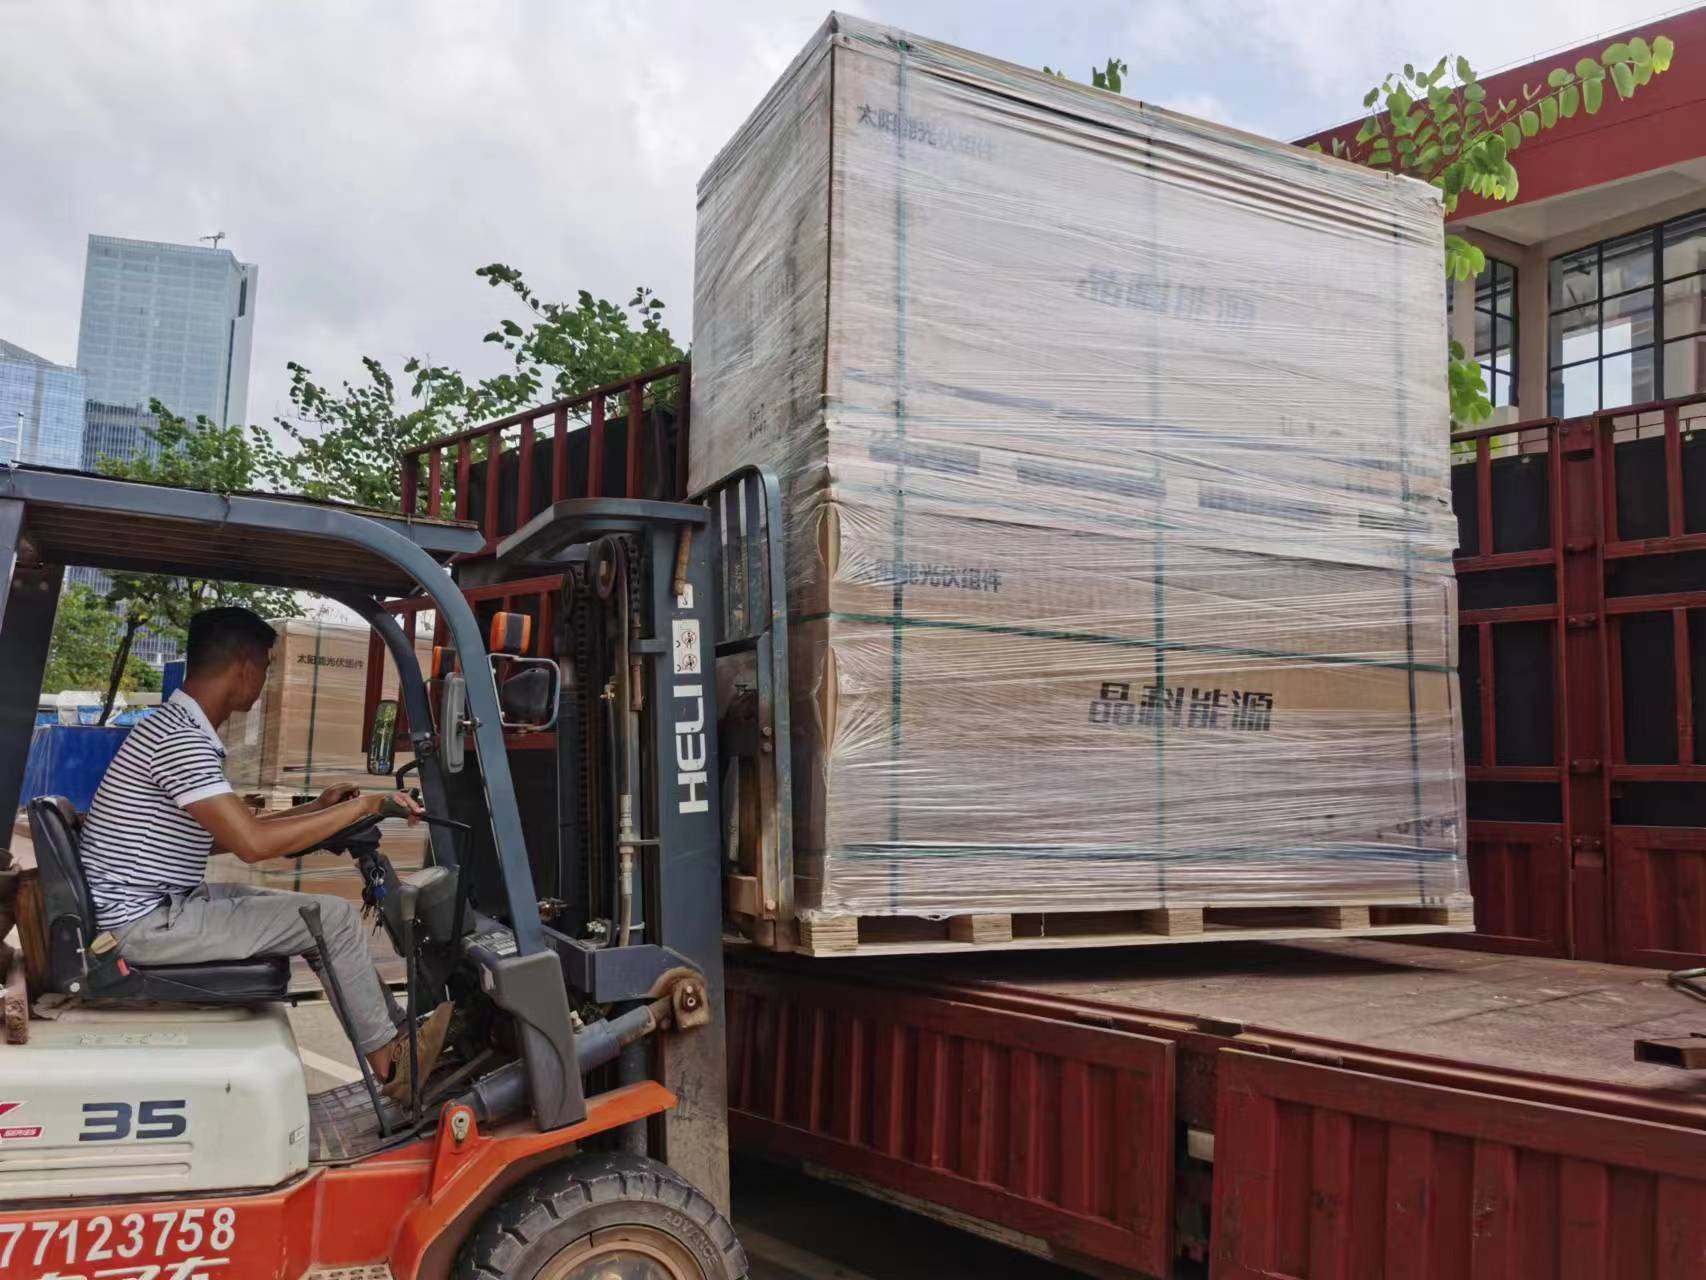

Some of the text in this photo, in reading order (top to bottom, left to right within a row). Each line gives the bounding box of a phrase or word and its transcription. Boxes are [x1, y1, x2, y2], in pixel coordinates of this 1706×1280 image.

[1088, 682, 1273, 731] 晶科能源
[673, 684, 709, 814] HELI
[79, 1100, 187, 1141] 35
[0, 1207, 236, 1269] 77123758
